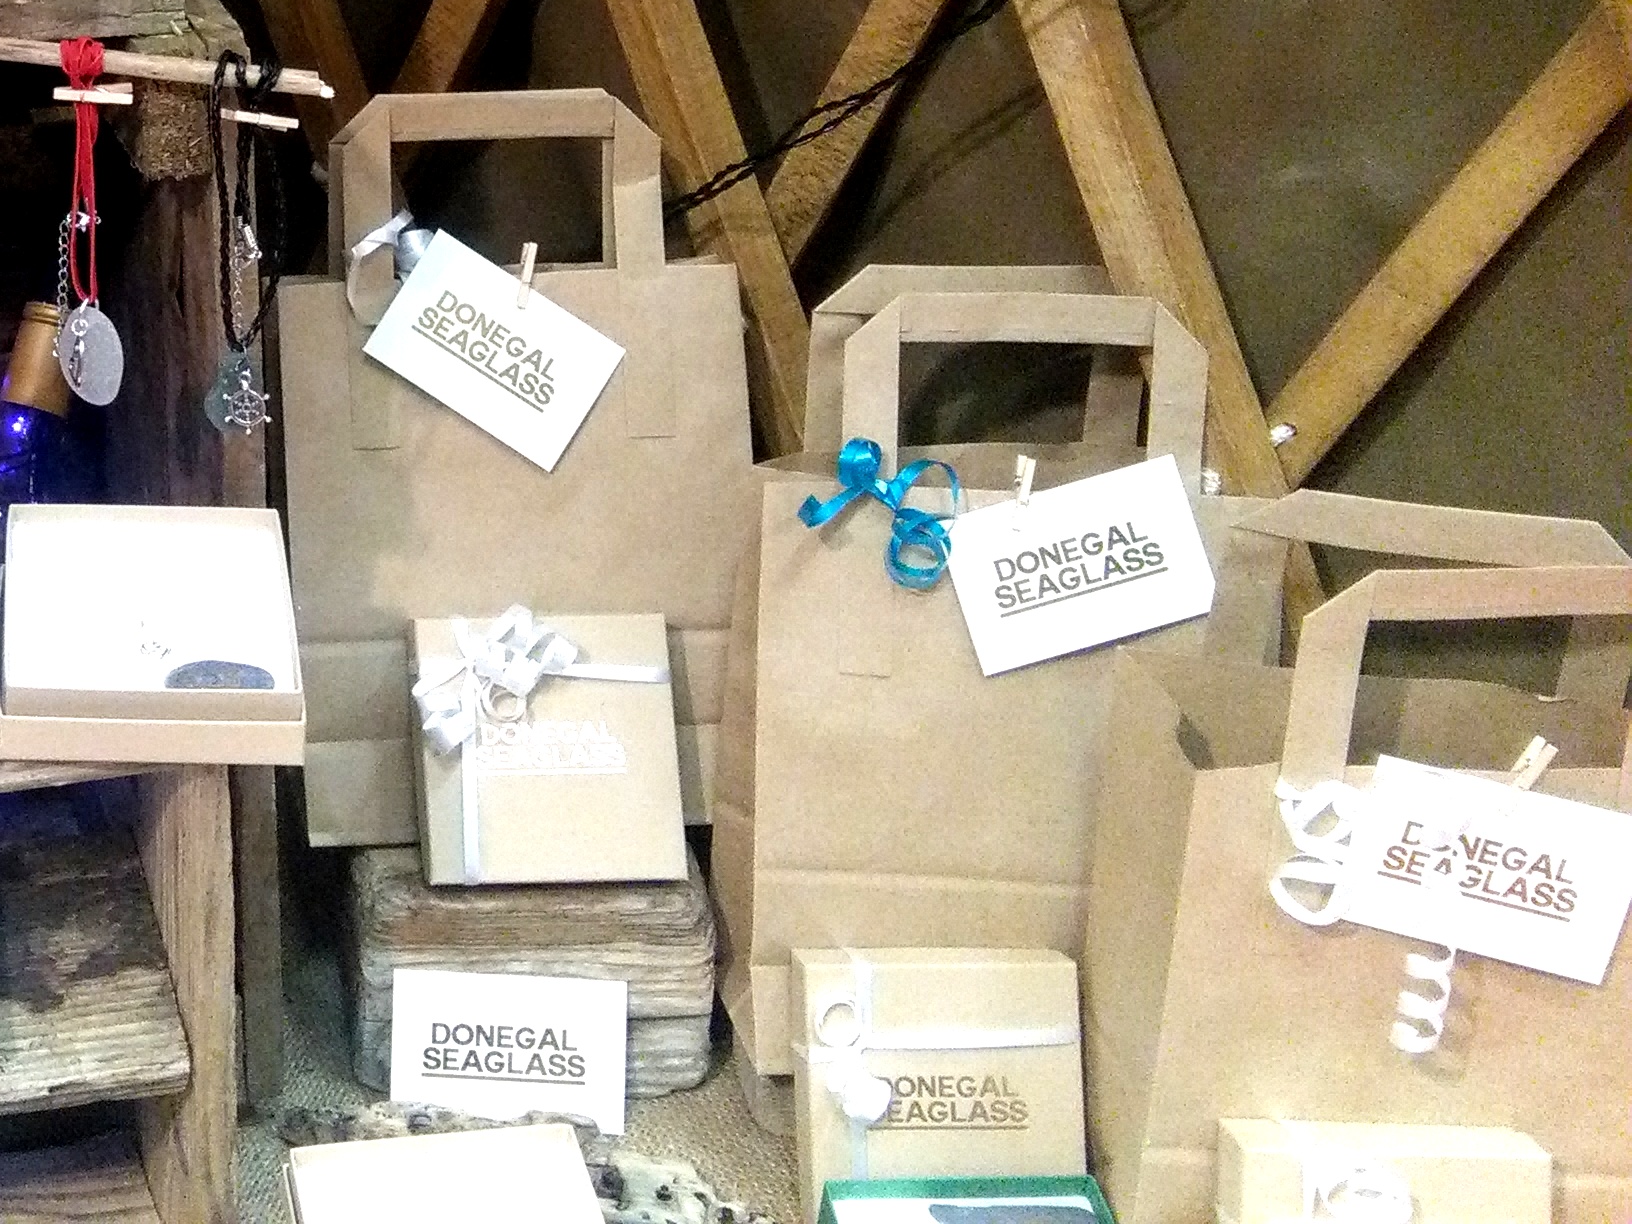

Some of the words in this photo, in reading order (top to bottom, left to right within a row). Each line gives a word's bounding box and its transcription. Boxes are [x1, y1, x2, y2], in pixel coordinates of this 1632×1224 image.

[417, 306, 556, 406] SEAGLASS
[435, 289, 555, 382] DONEGAL
[993, 521, 1148, 582] DONEGAL
[994, 542, 1165, 610] SEAGLASS
[1401, 820, 1574, 885] DNEGAL
[422, 1047, 586, 1078] SEAGLASS
[431, 1022, 578, 1052] DONEGAL
[874, 1075, 1019, 1098] ONEGAL
[887, 1100, 1029, 1123] EAGLASS
